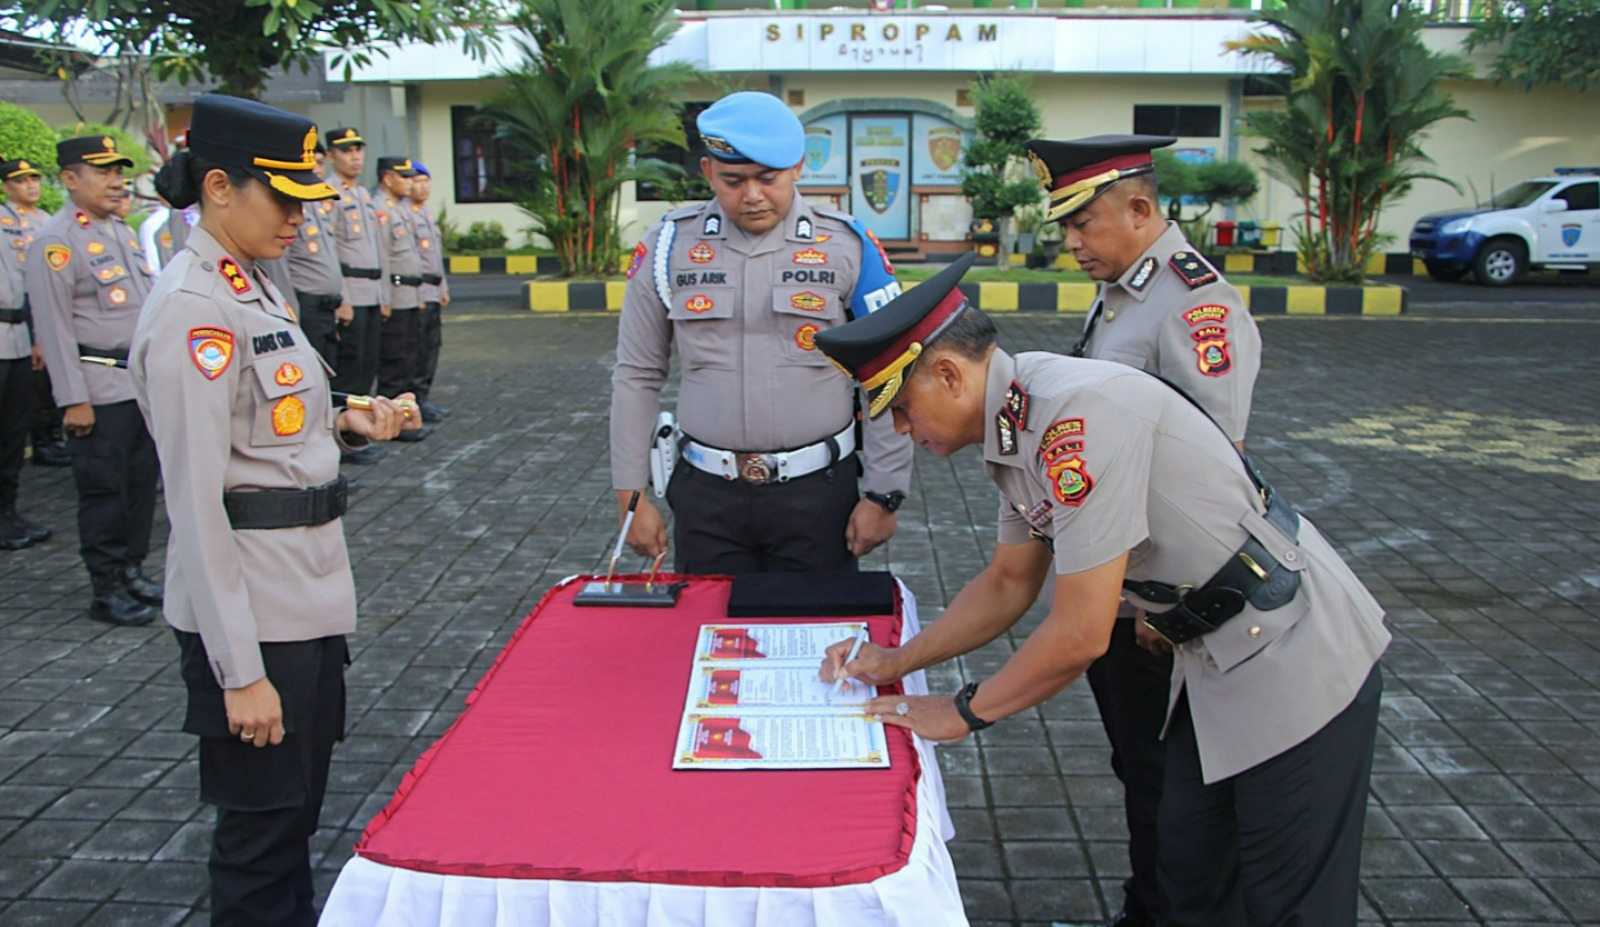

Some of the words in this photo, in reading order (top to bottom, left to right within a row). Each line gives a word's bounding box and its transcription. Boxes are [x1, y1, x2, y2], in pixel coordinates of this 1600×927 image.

[676, 272, 697, 287] GUS
[700, 272, 726, 286] ARIK
[782, 270, 835, 285] POLRI
[1046, 442, 1081, 460] BALI
